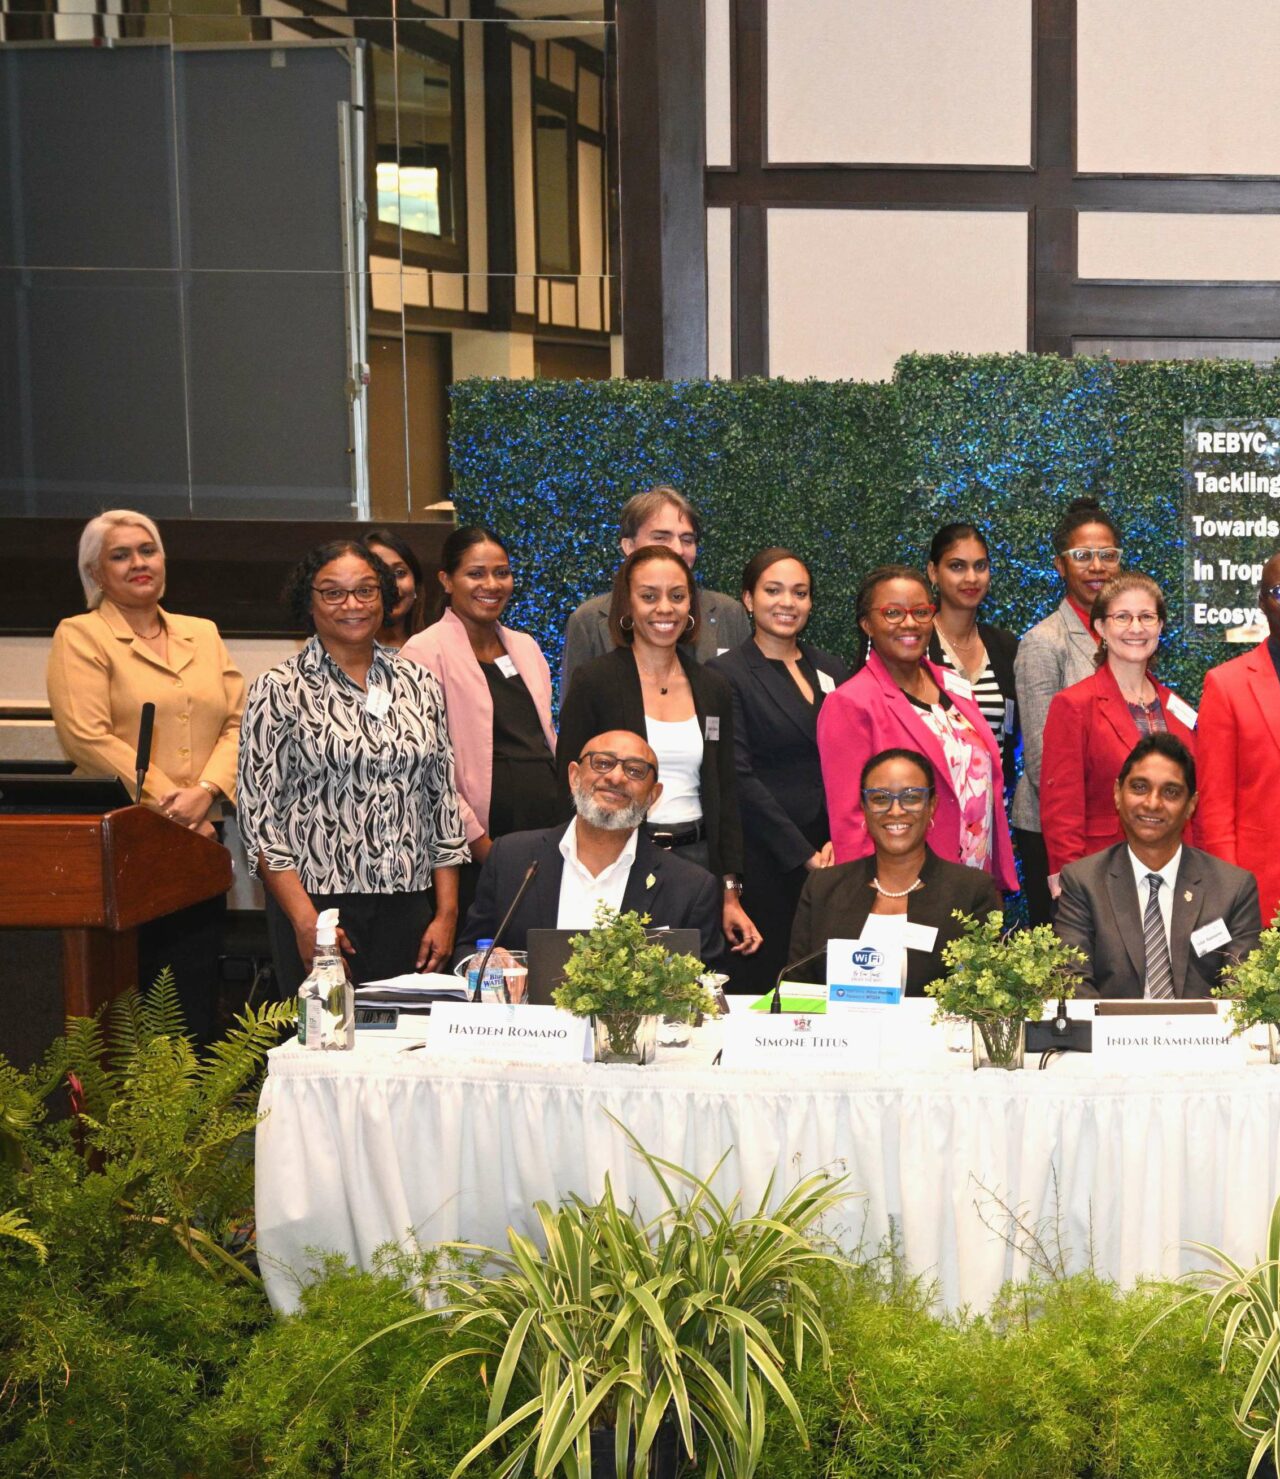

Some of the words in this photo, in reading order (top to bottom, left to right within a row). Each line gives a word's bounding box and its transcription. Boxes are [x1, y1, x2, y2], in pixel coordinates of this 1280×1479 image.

[1197, 432, 1268, 454] REBYC
[1192, 515, 1280, 538] Towards
[1193, 560, 1214, 581] In
[1219, 559, 1263, 585] Trop
[448, 1023, 504, 1036] HAYDEN
[508, 1026, 568, 1039] ROMANO
[754, 1035, 808, 1048] SIMONE
[812, 1036, 849, 1048] TITUS
[1106, 1036, 1149, 1046] INDAR
